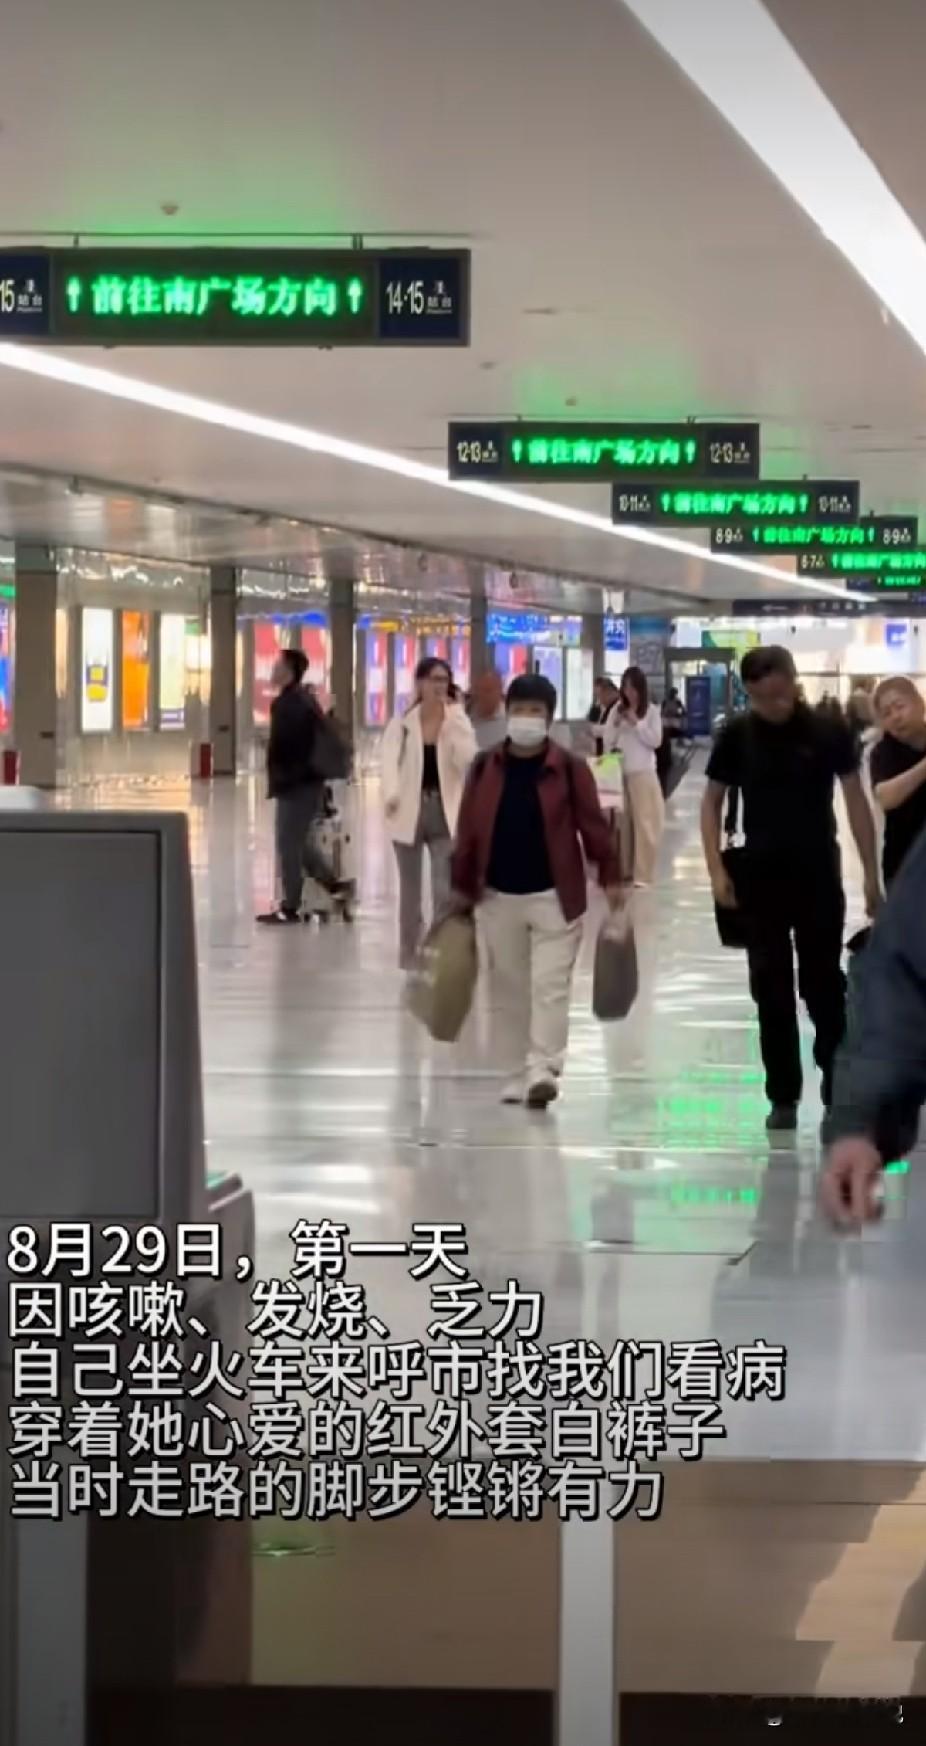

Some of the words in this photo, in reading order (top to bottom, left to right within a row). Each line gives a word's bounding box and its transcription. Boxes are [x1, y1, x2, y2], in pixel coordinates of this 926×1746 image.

[91, 275, 337, 316] 前往南广场方向
[527, 438, 680, 464] 前往南广场方向
[673, 491, 796, 514] 前往南广场方向
